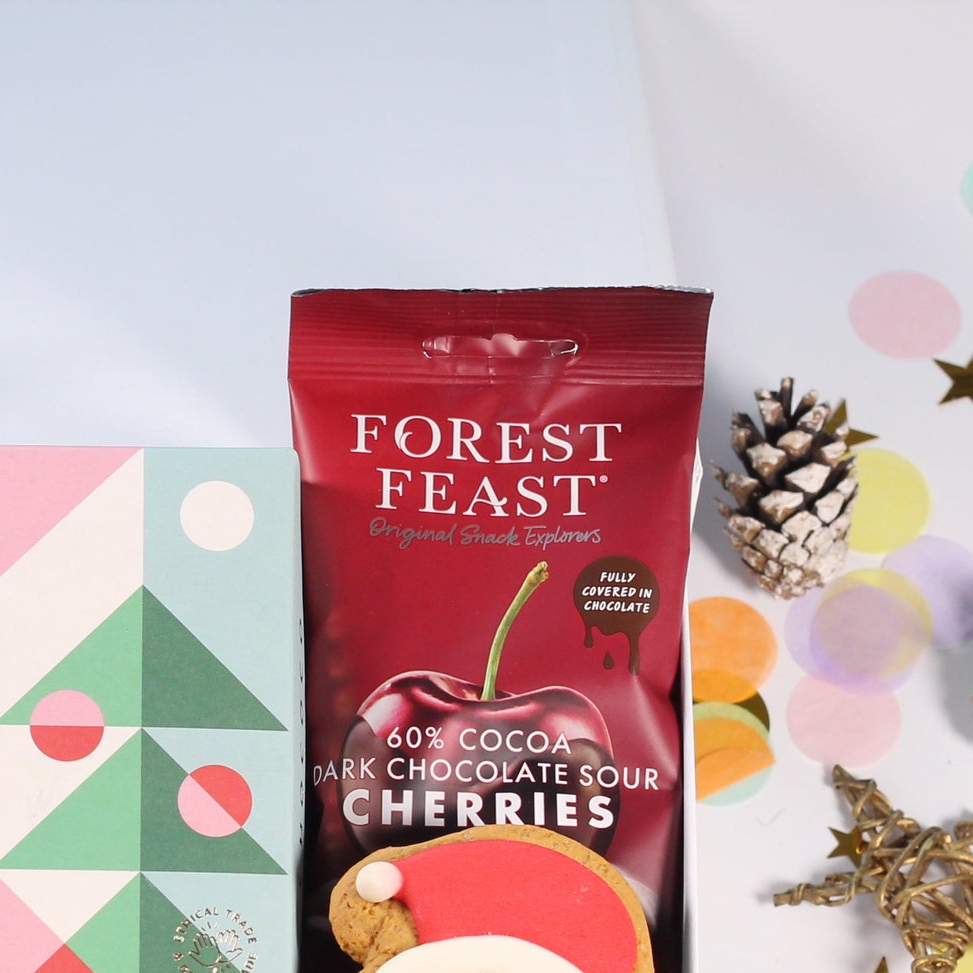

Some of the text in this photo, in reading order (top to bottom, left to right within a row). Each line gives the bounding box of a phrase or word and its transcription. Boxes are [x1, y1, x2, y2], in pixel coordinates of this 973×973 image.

[350, 413, 622, 464] FOREST
[369, 517, 602, 550] Original Snack Explorers
[581, 585, 653, 599] COVERED IN
[600, 572, 636, 584] FULLY
[583, 600, 651, 614] CHOCOLATE
[386, 726, 572, 754] 60% COCOA
[313, 758, 659, 790] DARK CHOCOLATE SOUR
[342, 788, 615, 829] CHERRIES
[225, 909, 257, 944] TRADE
